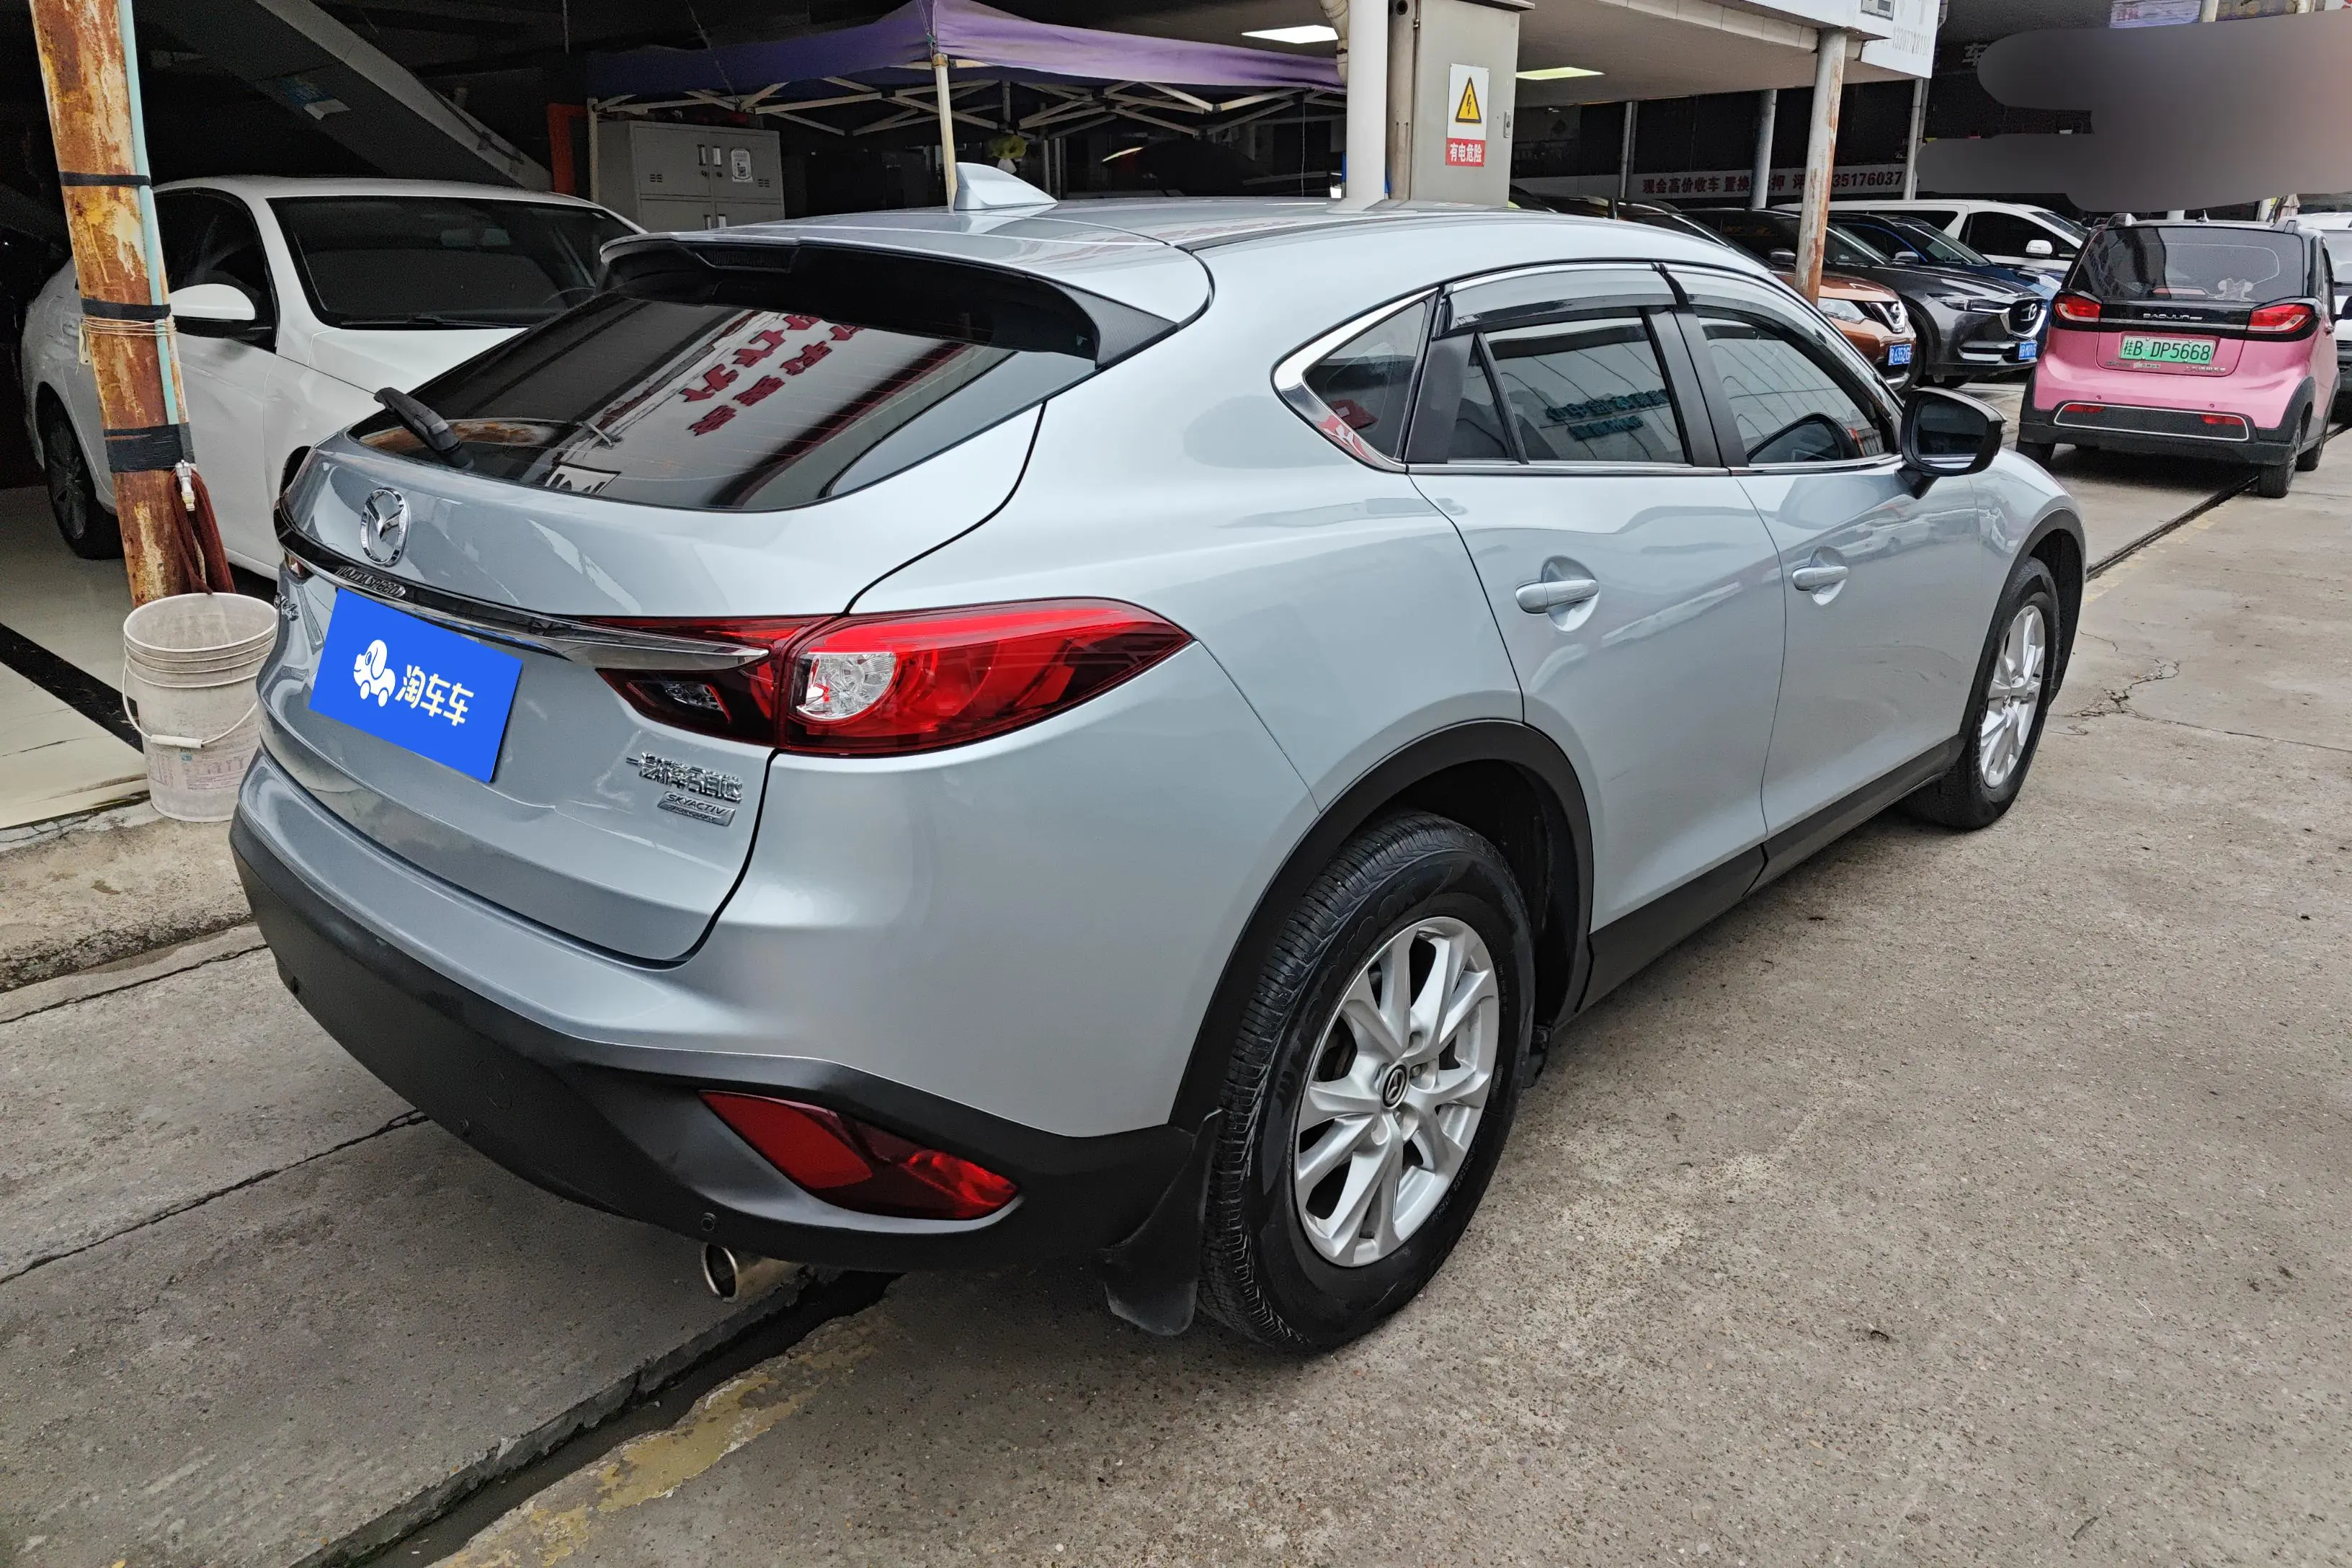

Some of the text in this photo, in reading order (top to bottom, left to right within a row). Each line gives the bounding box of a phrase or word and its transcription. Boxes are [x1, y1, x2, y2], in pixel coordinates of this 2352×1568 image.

[1450, 142, 1482, 163] 有电危险
[1642, 177, 1721, 195] 现金高价收车
[1723, 175, 1750, 193] 置换
[2150, 341, 2211, 361] DP5668
[666, 793, 726, 814] SKYACTIV
